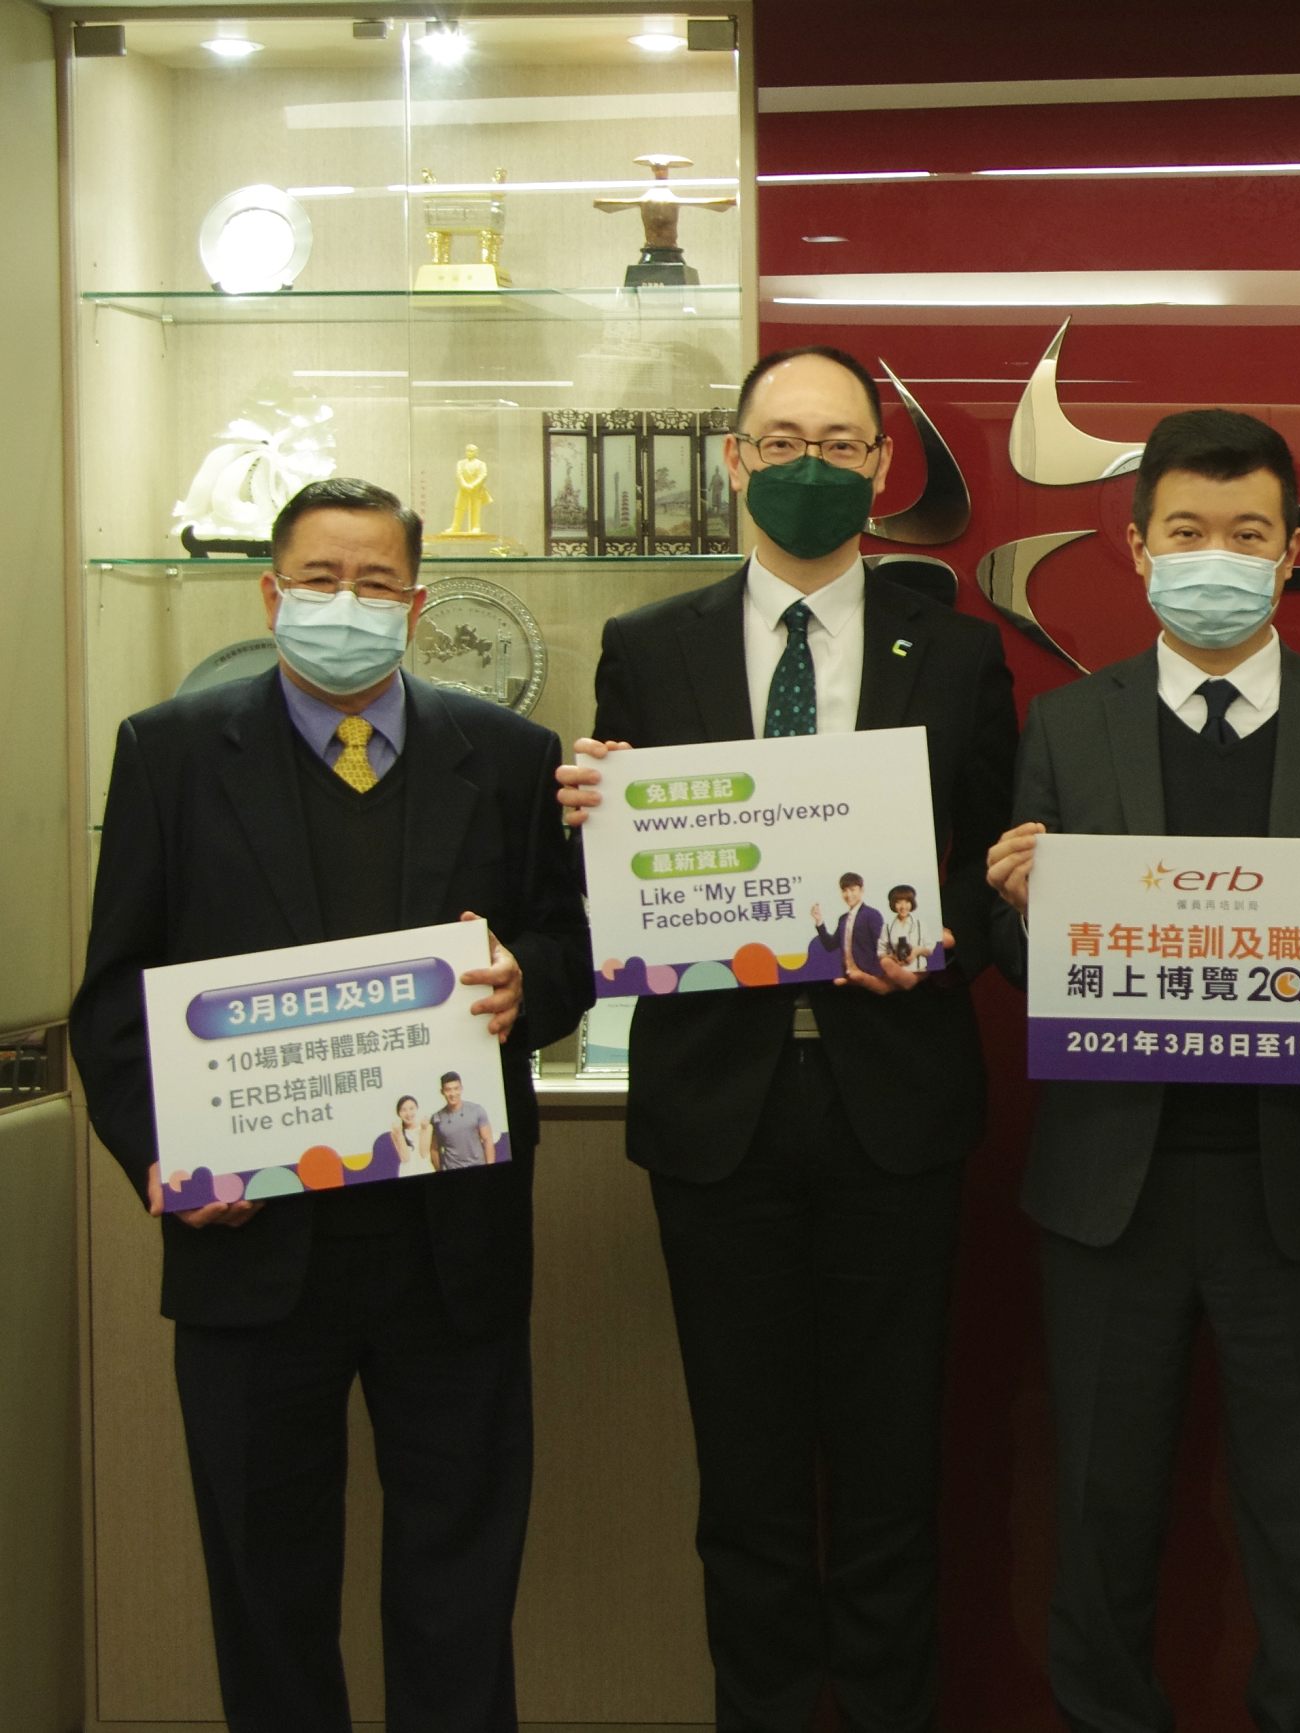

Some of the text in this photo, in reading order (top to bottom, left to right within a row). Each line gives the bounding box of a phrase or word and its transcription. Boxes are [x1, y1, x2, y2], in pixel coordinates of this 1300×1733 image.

[646, 779, 733, 803] 免費登記
[633, 801, 850, 833] www.erb.org/vexpo
[652, 849, 740, 873] 最新資訊
[1173, 865, 1264, 892] erb
[641, 887, 686, 907] Like
[642, 898, 796, 930] Facebook專頁
[228, 973, 417, 1026] 3月8日及9日
[226, 1022, 430, 1073] 10場實時體驗活動
[229, 1066, 384, 1110] ERB培訓顧問
[231, 1102, 334, 1134] live chat
